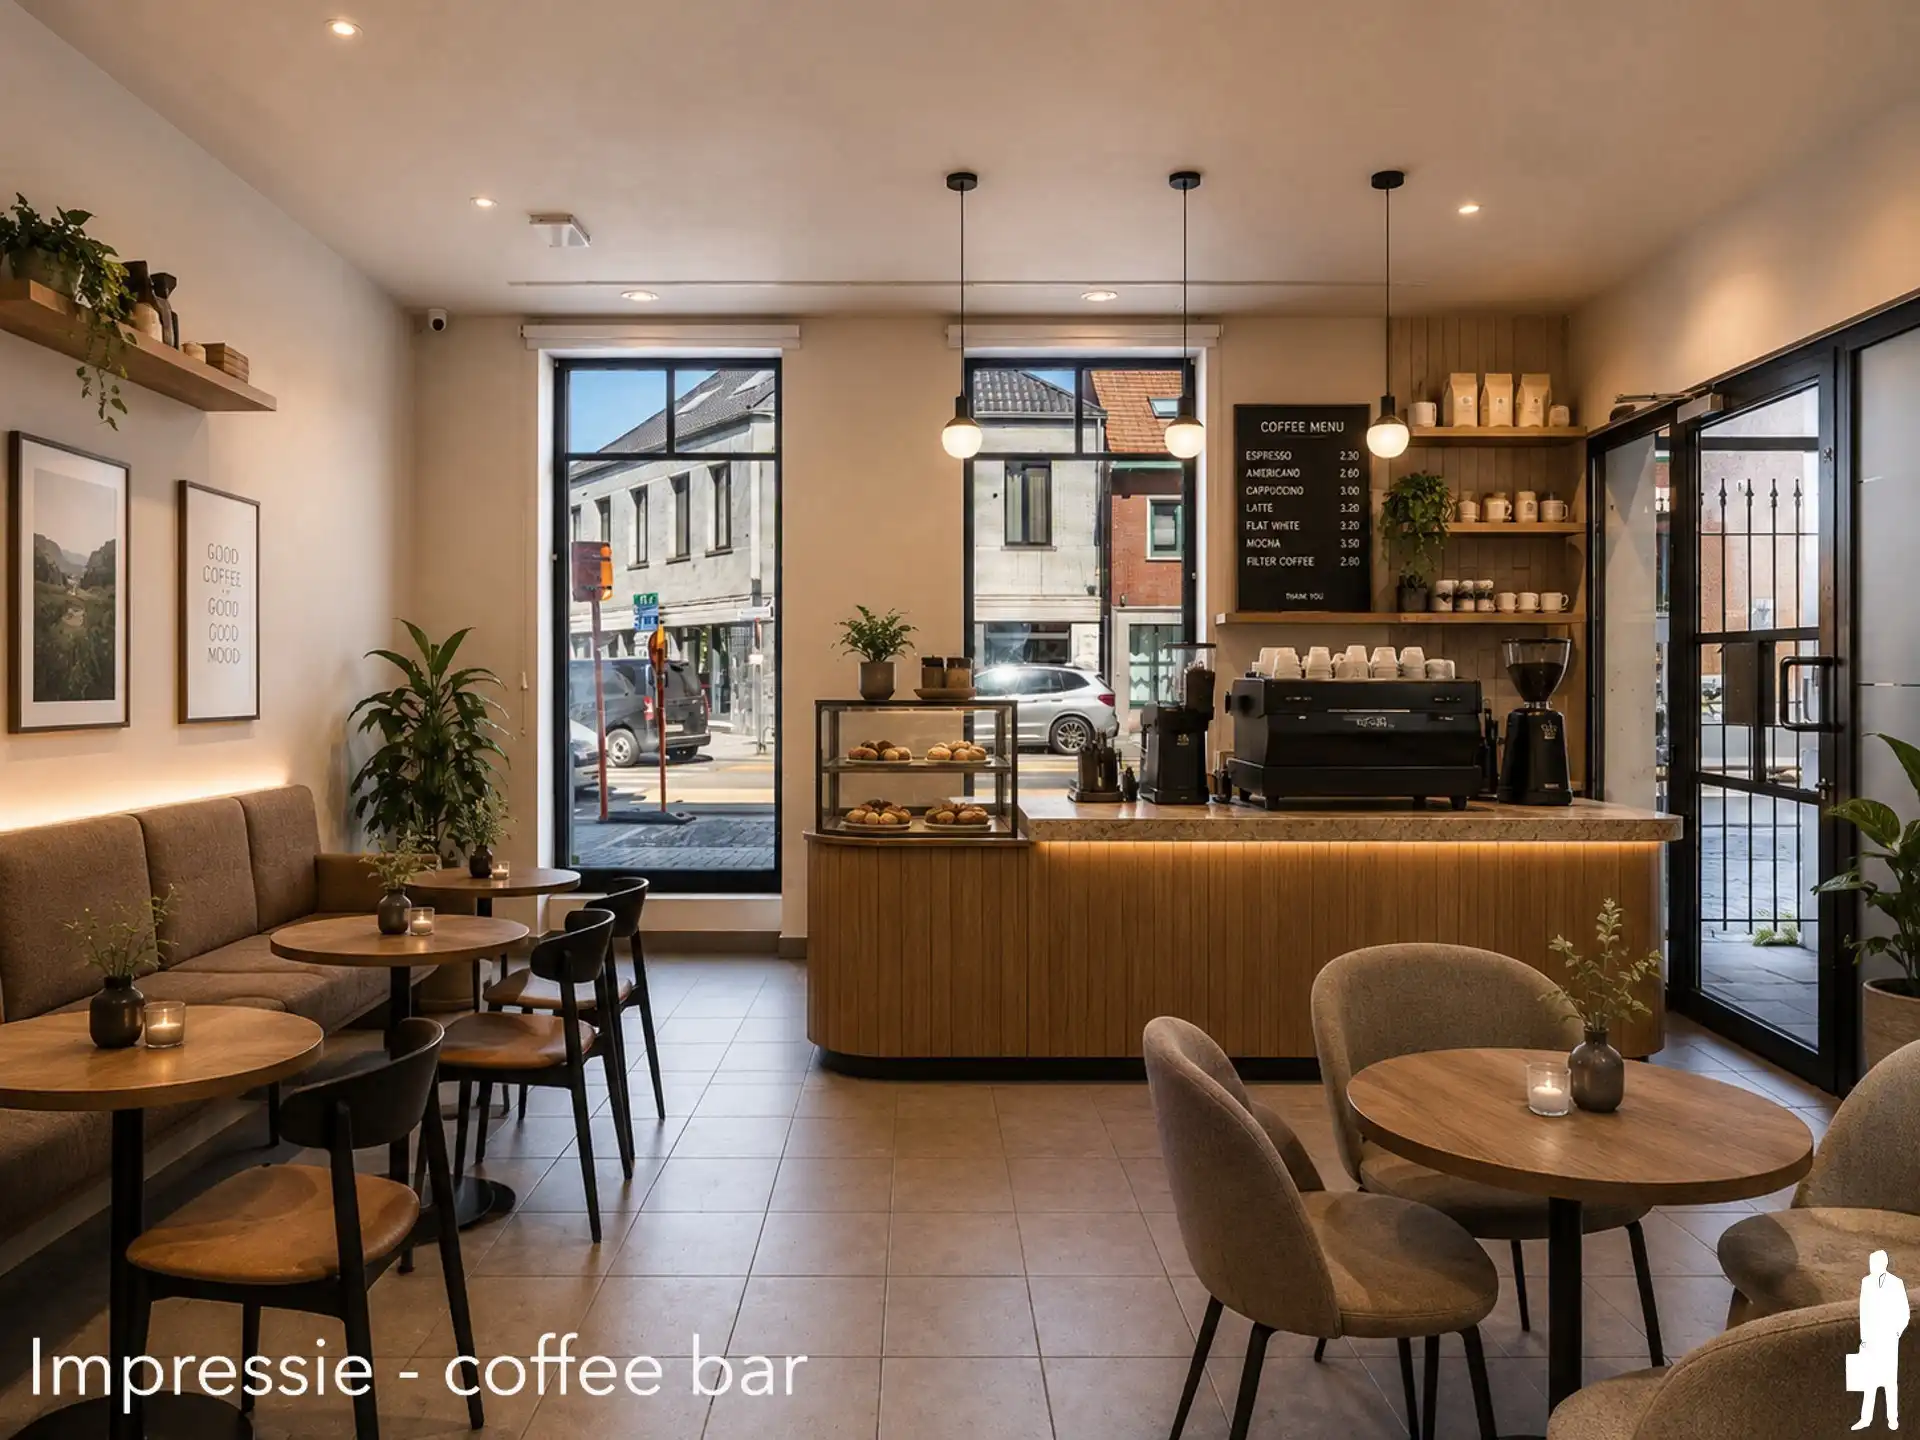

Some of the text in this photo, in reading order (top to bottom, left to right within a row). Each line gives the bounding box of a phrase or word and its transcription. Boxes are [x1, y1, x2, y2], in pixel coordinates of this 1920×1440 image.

[1260, 420, 1345, 433] COFFEE MENU
[1245, 450, 1292, 461] ESPRESSO
[1245, 467, 1301, 478] AMERICANO
[1340, 485, 1360, 496] 3.00
[1246, 502, 1360, 513] LATTE 3.20
[1246, 520, 1360, 531] FLAT WHITE 3.20
[1340, 538, 1360, 549] 3.50
[207, 543, 239, 565] GOOD
[1246, 556, 1277, 567] FILTER
[1278, 556, 1315, 567] COFFEE
[203, 565, 242, 588] COFFEE
[207, 597, 239, 618] GOOD
[208, 622, 239, 642] GOOD
[206, 647, 240, 664] MOOD
